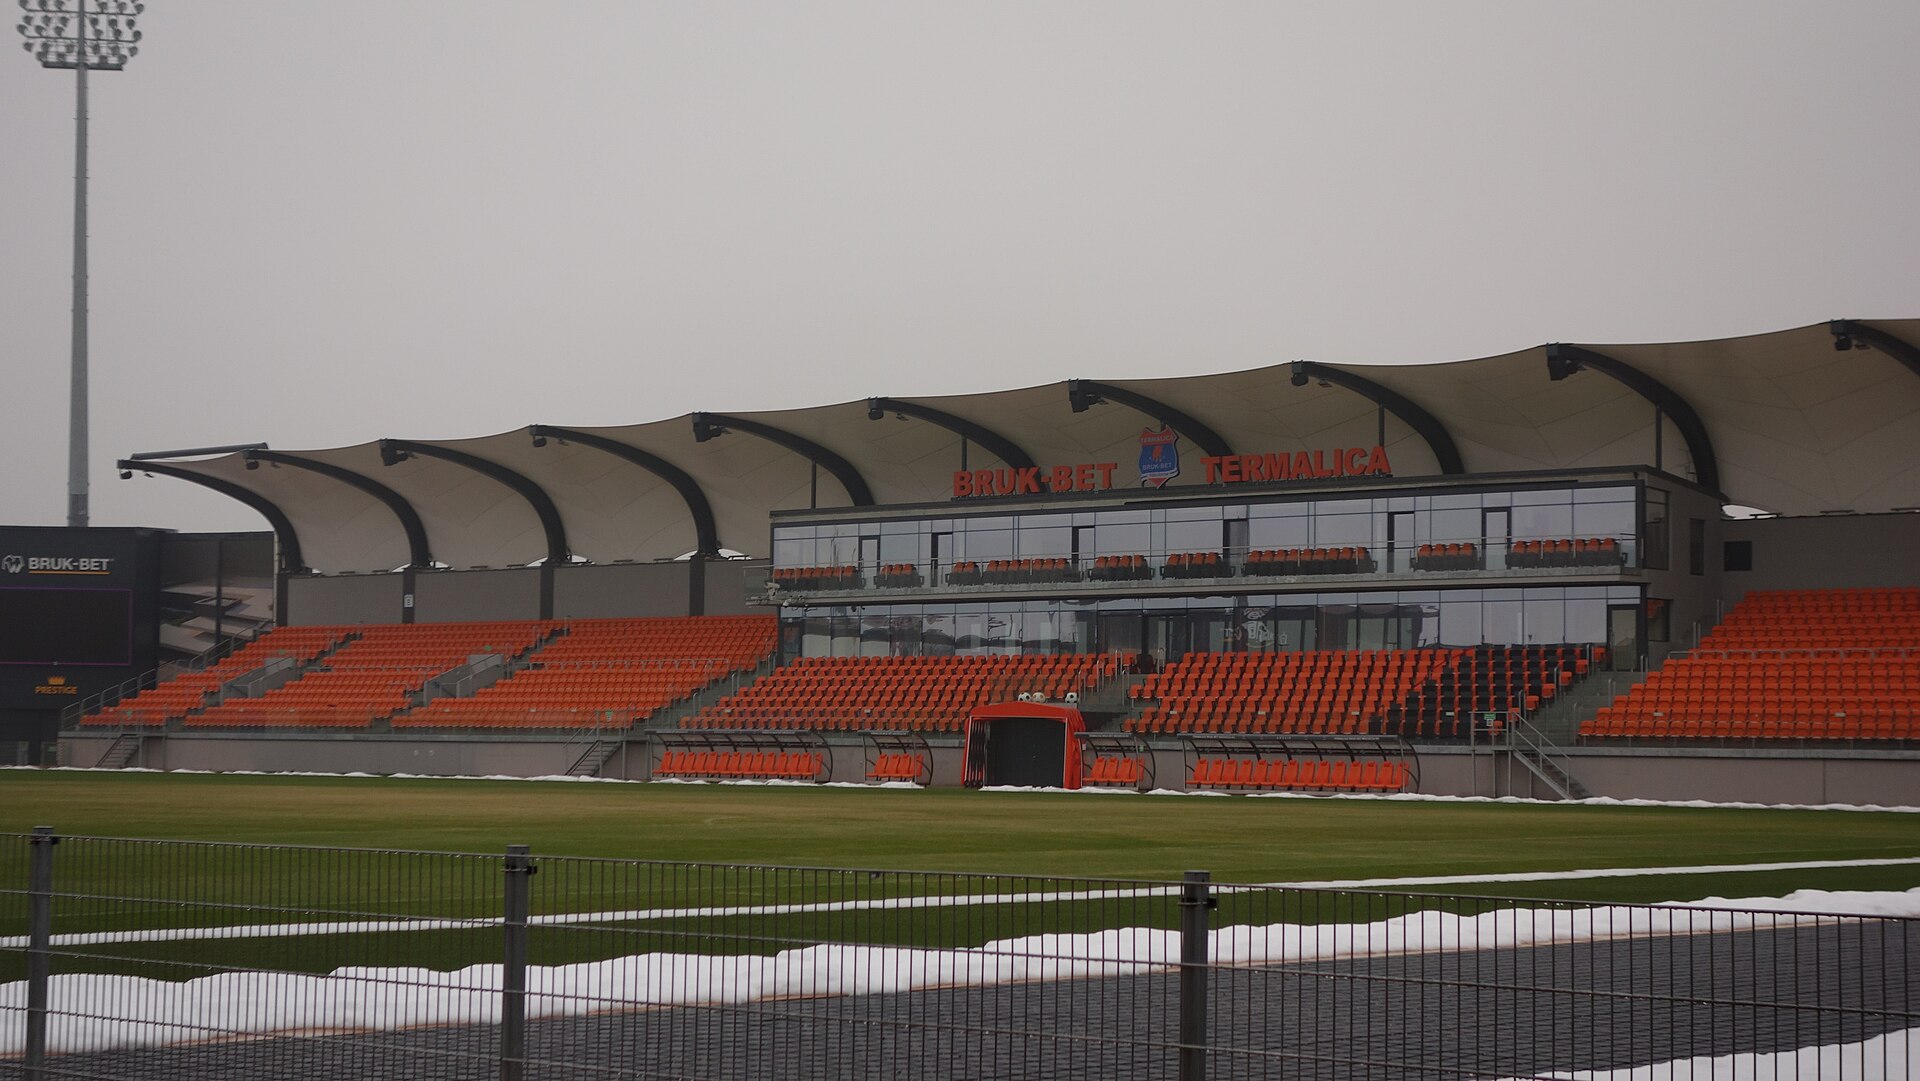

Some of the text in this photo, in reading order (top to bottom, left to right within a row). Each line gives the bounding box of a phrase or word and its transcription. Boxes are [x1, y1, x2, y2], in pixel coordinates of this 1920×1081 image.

[953, 446, 1392, 496] BRUK-BET TERMALICA
[1142, 462, 1172, 470] BRUK-BET
[28, 557, 110, 570] BRUK-BET
[34, 686, 78, 695] PRESTIGE
